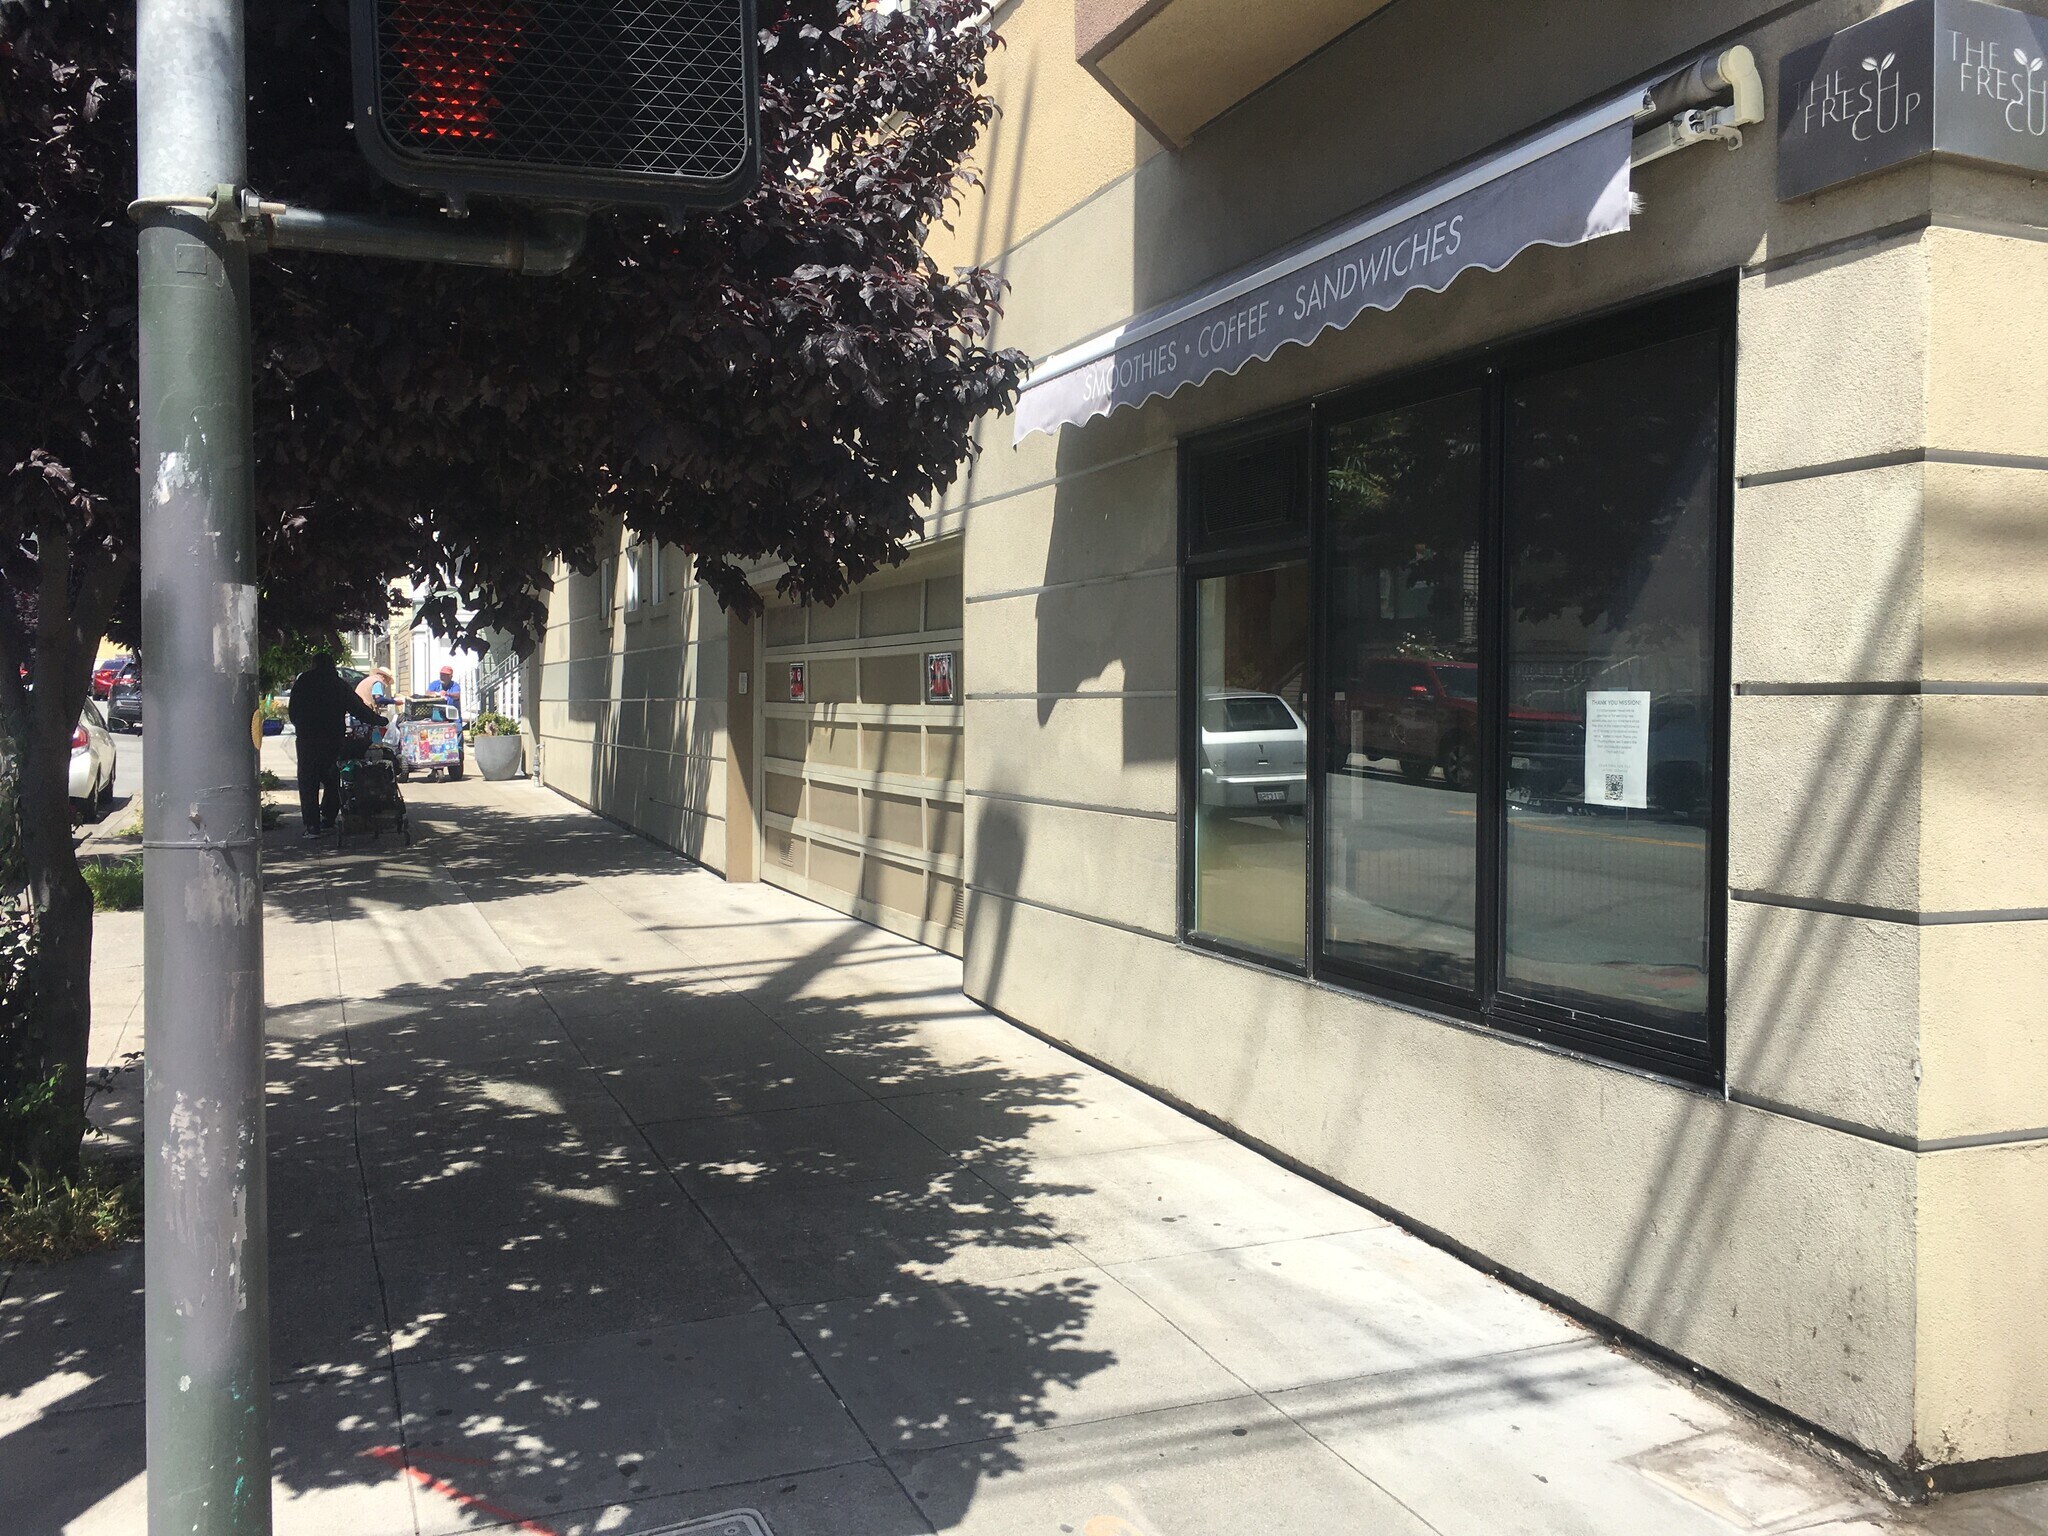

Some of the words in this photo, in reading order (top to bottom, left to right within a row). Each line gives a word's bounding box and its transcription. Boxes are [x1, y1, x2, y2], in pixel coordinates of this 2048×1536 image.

[1948, 29, 1999, 70] THE
[1792, 66, 1847, 111] THE
[1804, 71, 1899, 134] FRESH
[1961, 63, 2047, 106] FRESH
[1852, 92, 1921, 142] CUP
[1082, 340, 1178, 402] SMOOTHIES
[1197, 300, 1270, 359] COFFEE
[1293, 214, 1464, 321] SANDWICHES
